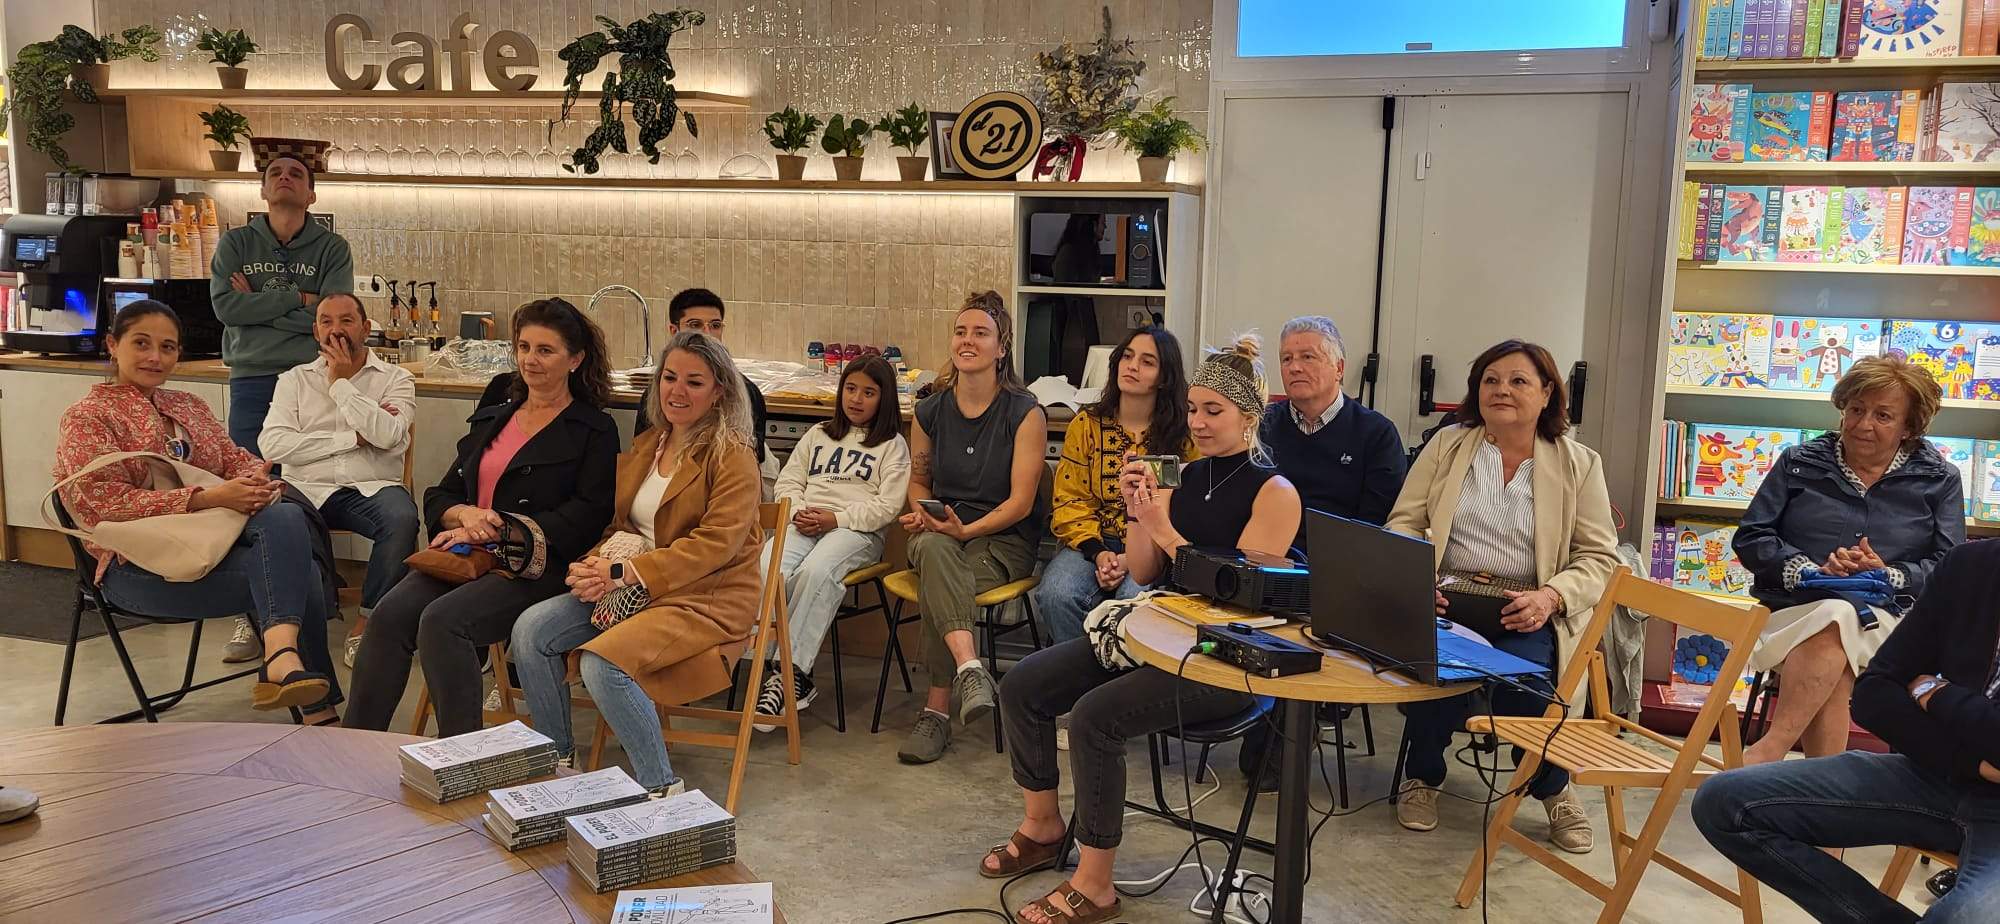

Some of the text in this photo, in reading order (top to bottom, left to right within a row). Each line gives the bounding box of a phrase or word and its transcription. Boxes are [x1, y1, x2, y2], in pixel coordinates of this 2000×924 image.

[325, 12, 540, 91] Cafe
[1941, 324, 1955, 339] 6
[604, 833, 618, 841] EL
[628, 897, 647, 922] PODER
